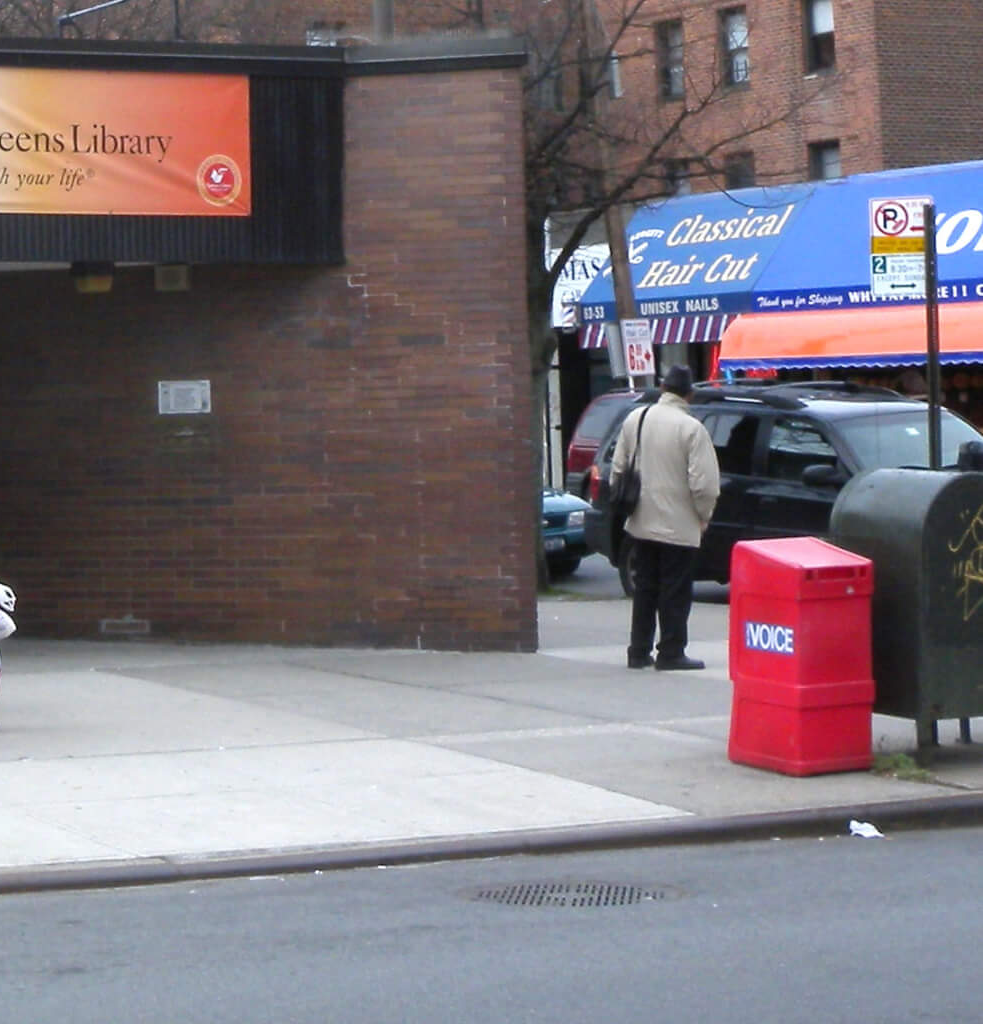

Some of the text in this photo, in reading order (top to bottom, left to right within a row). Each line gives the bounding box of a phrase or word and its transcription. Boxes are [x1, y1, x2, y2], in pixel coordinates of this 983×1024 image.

[72, 123, 173, 163] Library
[15, 171, 54, 191] your
[666, 204, 794, 248] Classical
[636, 252, 759, 289] Hair Cut
[874, 256, 885, 273] 2
[640, 298, 719, 316] UNISEX NAILS
[756, 295, 780, 308] Thank
[781, 297, 794, 308] you
[795, 295, 806, 308] for
[808, 293, 843, 306] Shopping
[749, 622, 794, 653] VOICE
